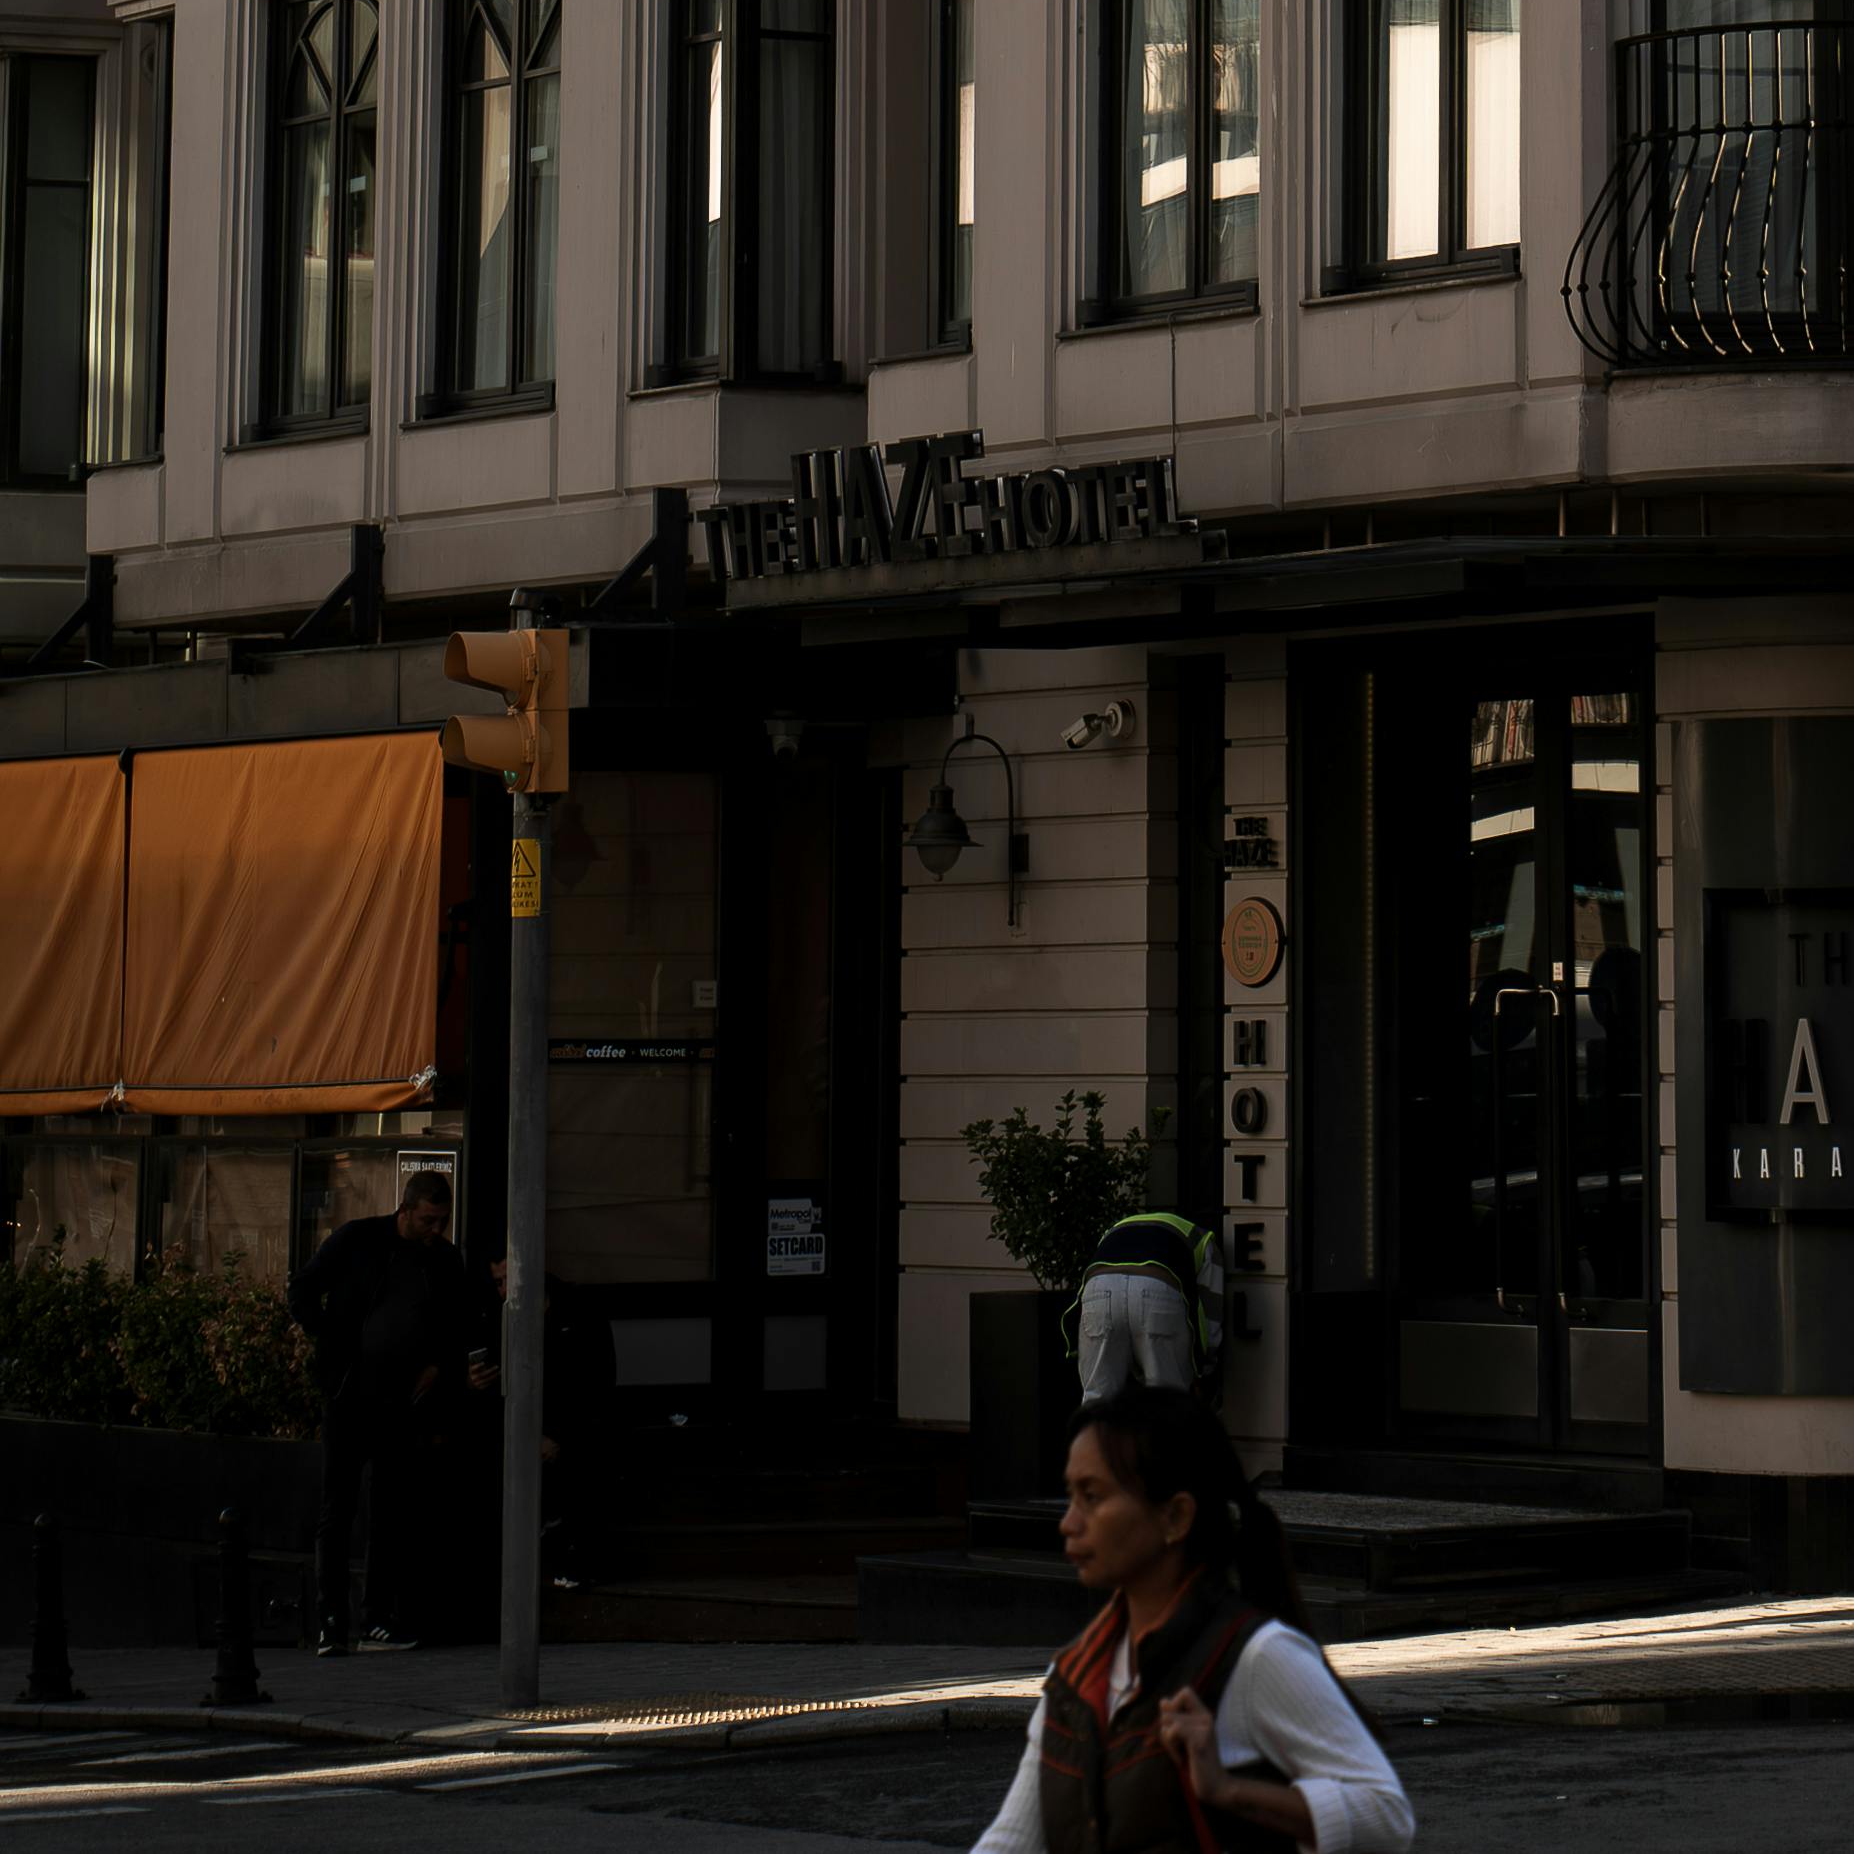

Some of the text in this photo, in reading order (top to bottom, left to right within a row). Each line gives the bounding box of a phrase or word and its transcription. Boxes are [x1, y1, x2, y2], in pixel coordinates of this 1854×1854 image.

[697, 429, 1199, 582] THE HAZE HOTEL
[586, 1044, 627, 1060] coffee
[639, 1046, 688, 1058] WELCOME
[1231, 1019, 1268, 1341] HOTEL
[769, 1237, 823, 1256] SETCARD
